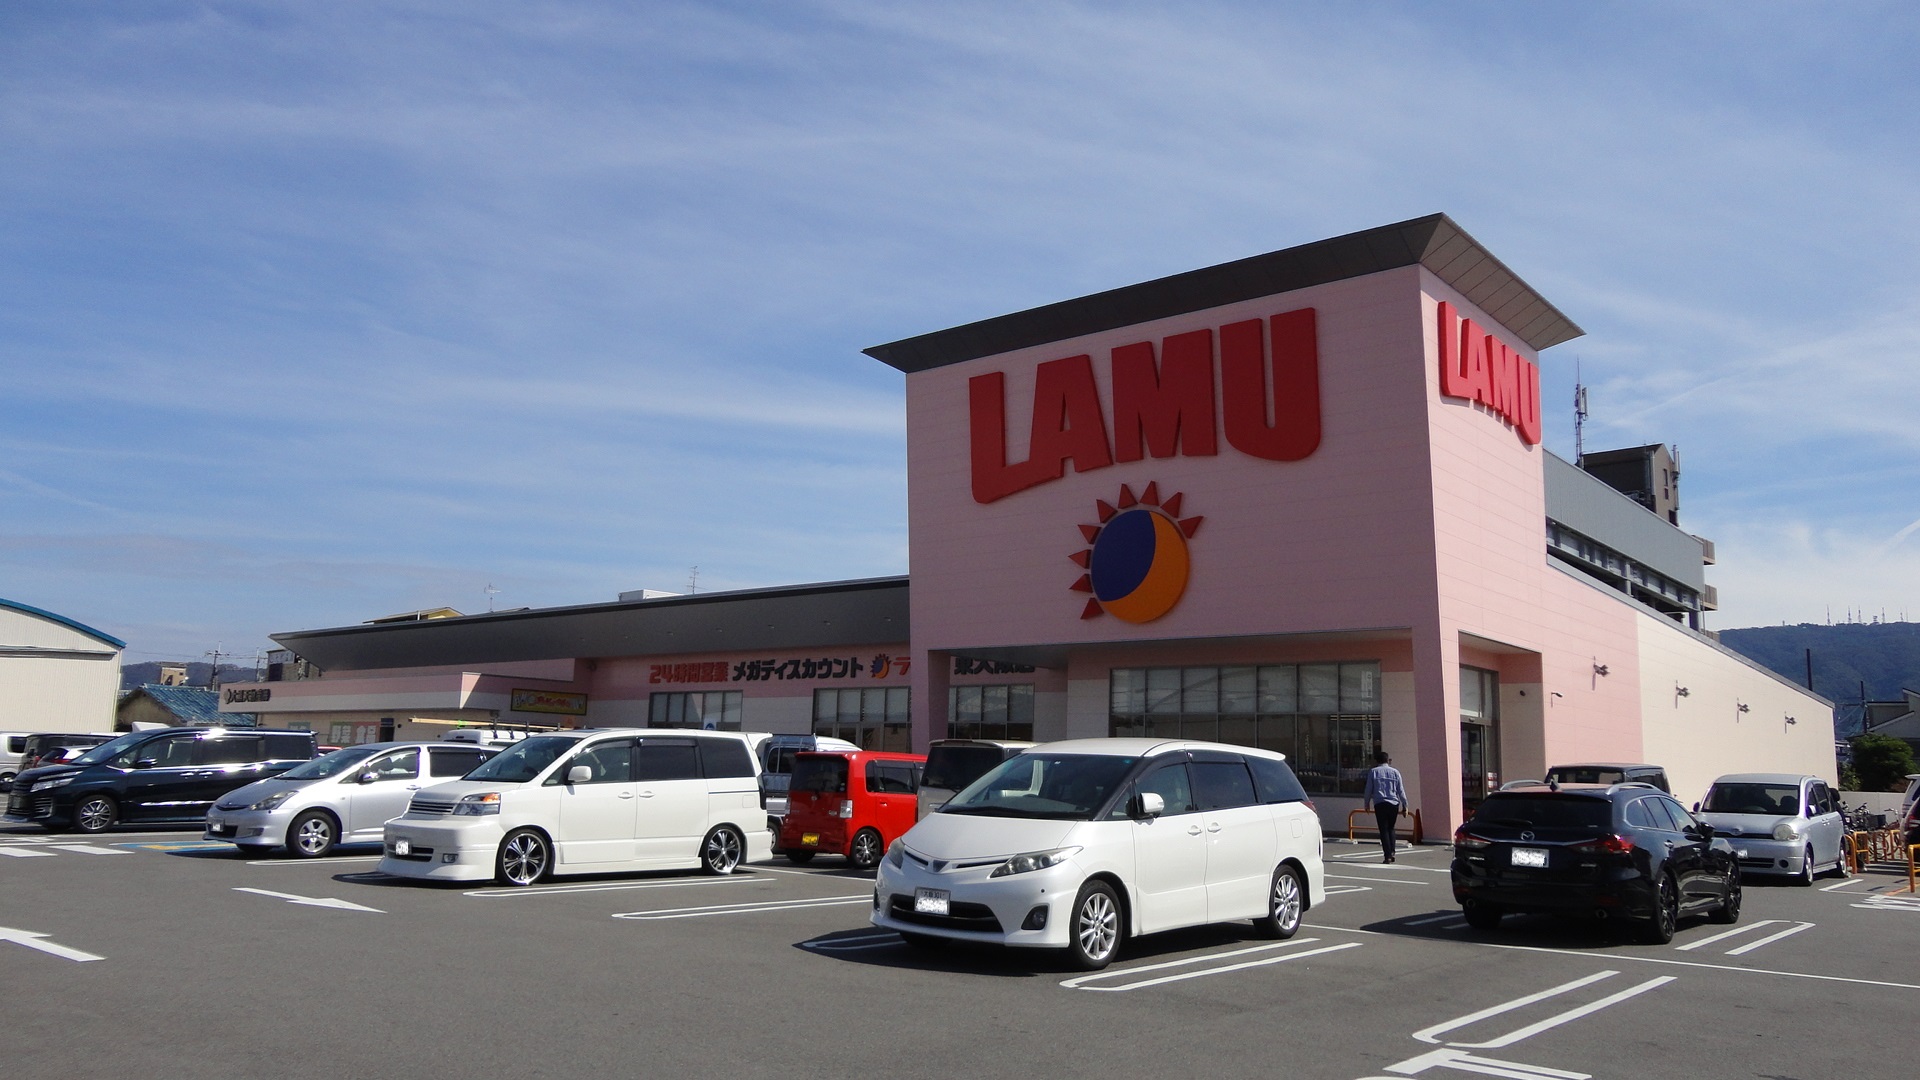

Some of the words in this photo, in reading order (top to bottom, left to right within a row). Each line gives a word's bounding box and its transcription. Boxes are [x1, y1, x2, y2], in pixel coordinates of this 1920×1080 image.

[969, 307, 1321, 504] LAMU
[1437, 301, 1541, 445] LAMU
[649, 662, 729, 684] 24時間営業
[732, 657, 864, 681] メガディスカウント
